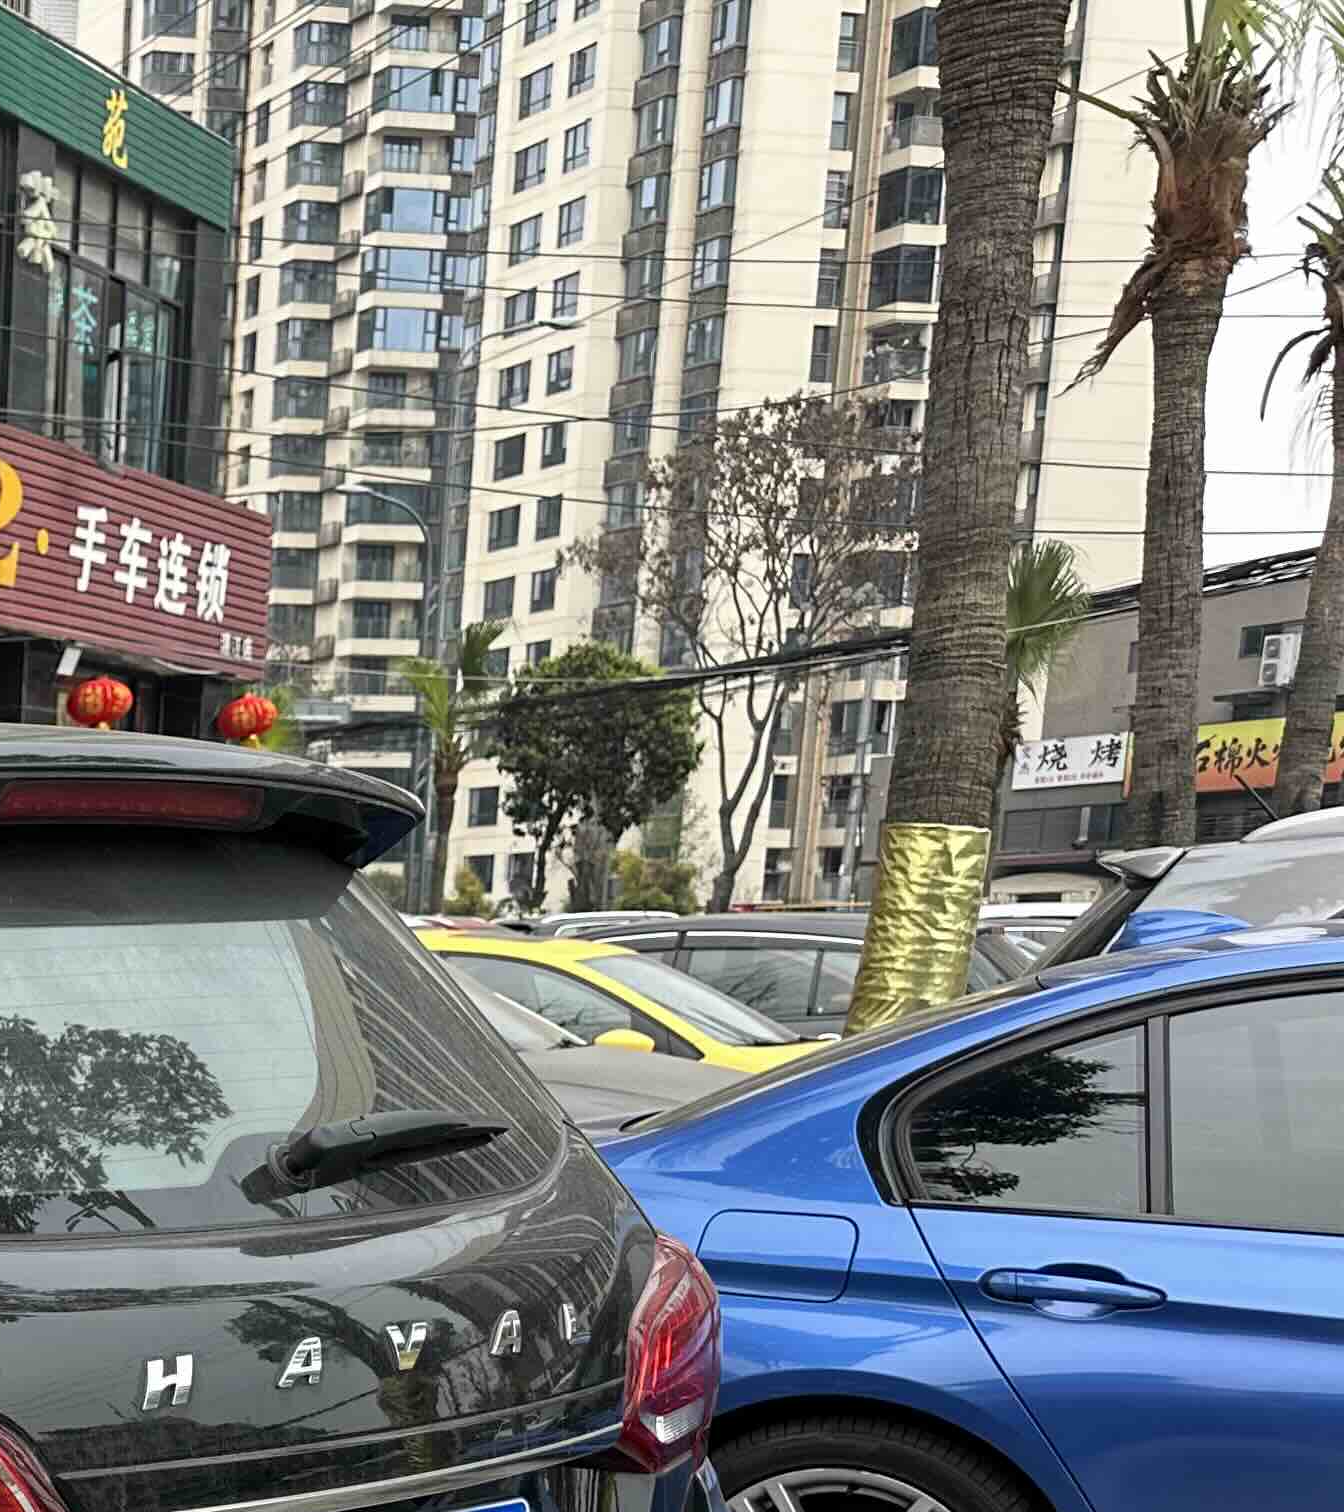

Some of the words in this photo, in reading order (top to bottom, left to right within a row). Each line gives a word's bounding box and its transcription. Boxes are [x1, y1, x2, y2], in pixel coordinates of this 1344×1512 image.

[70, 287, 99, 354] 茶
[1036, 738, 1122, 772] 烧烤
[142, 1303, 592, 1411] HAVAL
